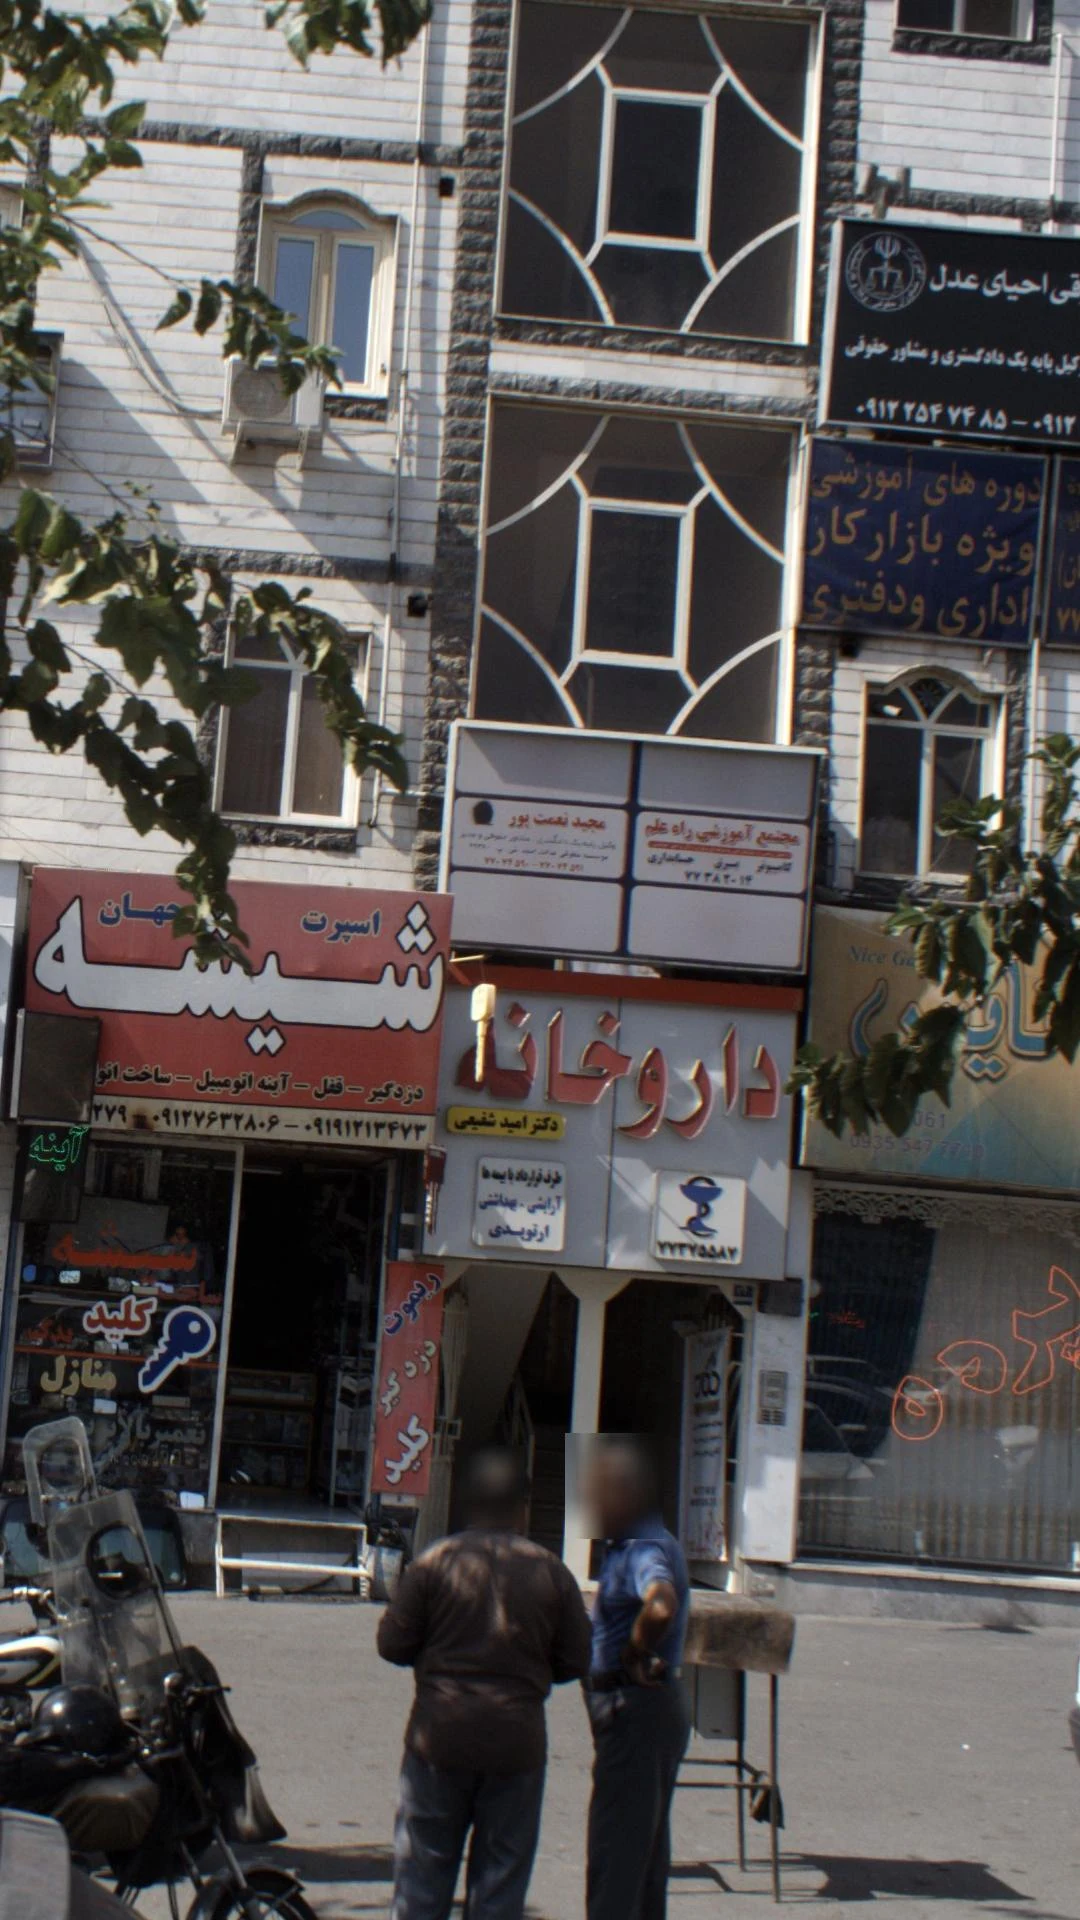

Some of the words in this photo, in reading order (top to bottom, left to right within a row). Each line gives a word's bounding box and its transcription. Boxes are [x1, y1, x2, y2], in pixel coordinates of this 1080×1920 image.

[929, 264, 980, 291] عدل
[983, 269, 1049, 302] احیای
[844, 335, 889, 359] حقوقی
[891, 340, 928, 362] مشاور
[929, 350, 938, 366] و
[941, 348, 1005, 368] دادگستری
[1007, 352, 1027, 372] یک
[1031, 353, 1054, 375] پایه
[1055, 356, 1080, 378] کیل
[923, 460, 977, 507] های
[984, 476, 1042, 515] دوره
[809, 504, 869, 558] کار
[864, 509, 943, 566] بازار
[956, 524, 1035, 577] ویژه
[935, 581, 1031, 638] اداری
[533, 810, 570, 829] نعمت
[571, 813, 608, 833] مجید
[644, 817, 669, 837] علم
[670, 819, 694, 841] راه
[695, 823, 754, 845] آموزشی
[755, 829, 800, 848] مجتمع
[301, 909, 381, 943] اسپرت
[849, 945, 886, 966] Nice
[33, 895, 446, 1058] شیشه
[121, 1064, 171, 1086] ساخت
[454, 1001, 781, 1140] داروخانه
[194, 1070, 255, 1096] اتومبیل
[257, 1072, 290, 1093] آینه
[313, 1075, 346, 1099] قفل
[365, 1081, 424, 1106] دزدگیر
[453, 1111, 497, 1131] شفیعی
[499, 1114, 528, 1134] امید
[528, 1116, 559, 1136] دکتر
[28, 1124, 90, 1173] آینه
[478, 1191, 518, 1212] بهداشتی
[527, 1194, 563, 1216] آرایشی
[82, 1296, 157, 1342] کلید
[40, 1354, 117, 1398] منازل
[384, 1412, 431, 1486] کلید
